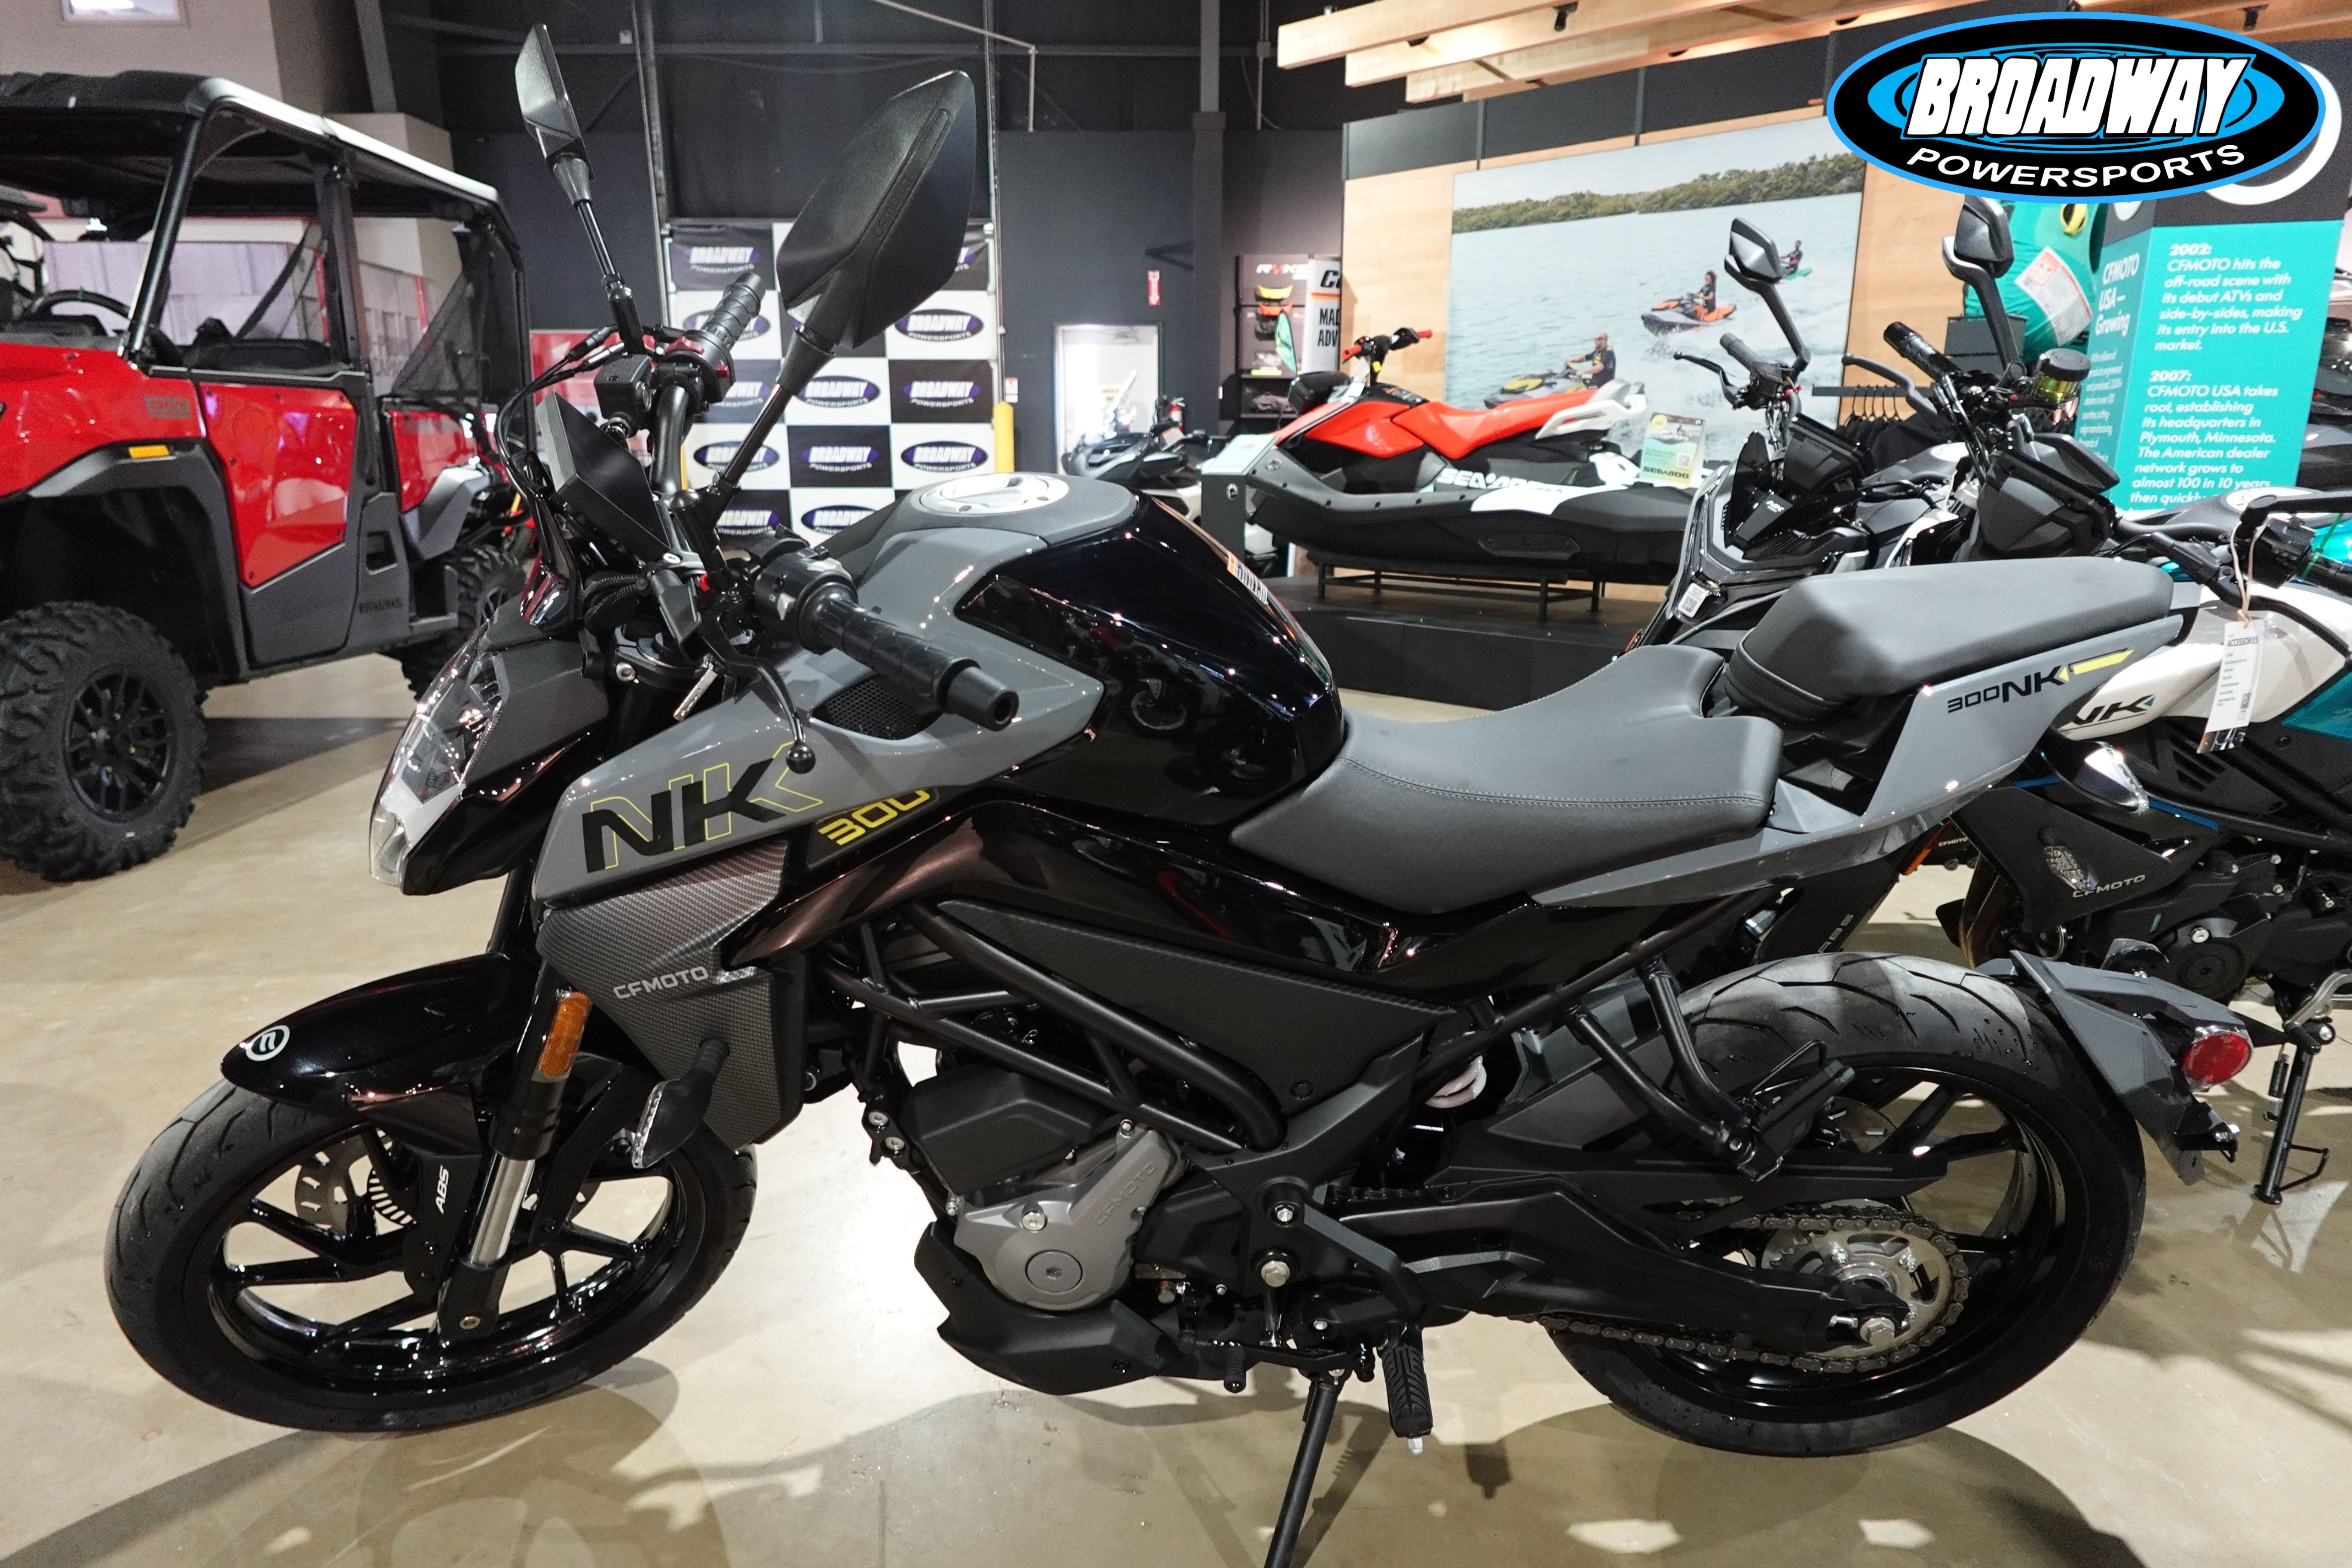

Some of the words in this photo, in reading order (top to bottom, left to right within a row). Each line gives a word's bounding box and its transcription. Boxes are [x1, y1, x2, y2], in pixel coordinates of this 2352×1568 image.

[689, 247, 753, 263] BROADWAY
[2170, 243, 2212, 256] 2002:
[690, 263, 755, 274] POWERSPORTS
[2103, 253, 2140, 285] CFMOTO
[2167, 258, 2231, 273] CFMOTO
[2234, 257, 2257, 271] hits
[2259, 257, 2281, 270] the
[2164, 274, 2221, 288] off-road
[2223, 276, 2260, 287] scene
[2263, 273, 2291, 286] with
[2099, 287, 2117, 312] USA
[2162, 292, 2177, 303] its
[2179, 290, 2219, 303] debut
[2220, 290, 2253, 303] ATVs
[2254, 289, 2284, 302] and
[2159, 306, 2250, 322] side-by-sides,
[2252, 305, 2303, 321] making
[906, 314, 971, 331] BROADWAY
[2095, 309, 2131, 337] Growing
[2157, 325, 2173, 336] its
[2174, 325, 2209, 338] entry
[2211, 323, 2237, 335] into
[2239, 322, 2261, 334] the
[2264, 321, 2289, 334] U.S.
[908, 331, 972, 341] POWERSPORTS
[2154, 338, 2202, 351] market.
[2150, 370, 2192, 382] 2007:
[805, 381, 868, 398] BROADWAY
[910, 381, 974, 398] BROADWAY
[2147, 385, 2210, 398] CFMOTO
[2211, 385, 2241, 397] USA
[2243, 384, 2279, 397] takes
[806, 398, 868, 407] POWERSPORTS
[910, 397, 974, 407] POWERSPORTS
[2144, 401, 2174, 415] root,
[2176, 400, 2254, 416] establishing
[2142, 417, 2156, 428] its
[2158, 416, 2247, 431] headquarters
[2248, 416, 2261, 428] in
[2140, 432, 2202, 446] Plymouth,
[2204, 431, 2276, 444] Minnesota.
[809, 446, 872, 463] BROADWAY
[913, 446, 976, 462] BROADWAY
[2138, 446, 2160, 458] The
[2162, 446, 2224, 459] American
[2226, 446, 2270, 458] dealer
[809, 462, 873, 472] POWERSPORTS
[914, 462, 977, 472] POWERSPORTS
[2135, 461, 2187, 473] network
[2187, 464, 2227, 476] grows
[2230, 463, 2244, 474] to
[2132, 477, 2175, 489] almost
[2177, 477, 2201, 489] 100
[2202, 477, 2214, 489] in
[2217, 477, 2233, 489] 10
[2130, 492, 2157, 503] then
[2227, 636, 2258, 647] ACCESSORIES
[582, 759, 787, 873] NK
[818, 788, 930, 846] 300
[1938, 836, 1968, 847] CFMOTO
[2073, 874, 2146, 898] CFMOTO
[613, 965, 709, 1000] CFMOTO
[435, 1164, 450, 1214] ABS
